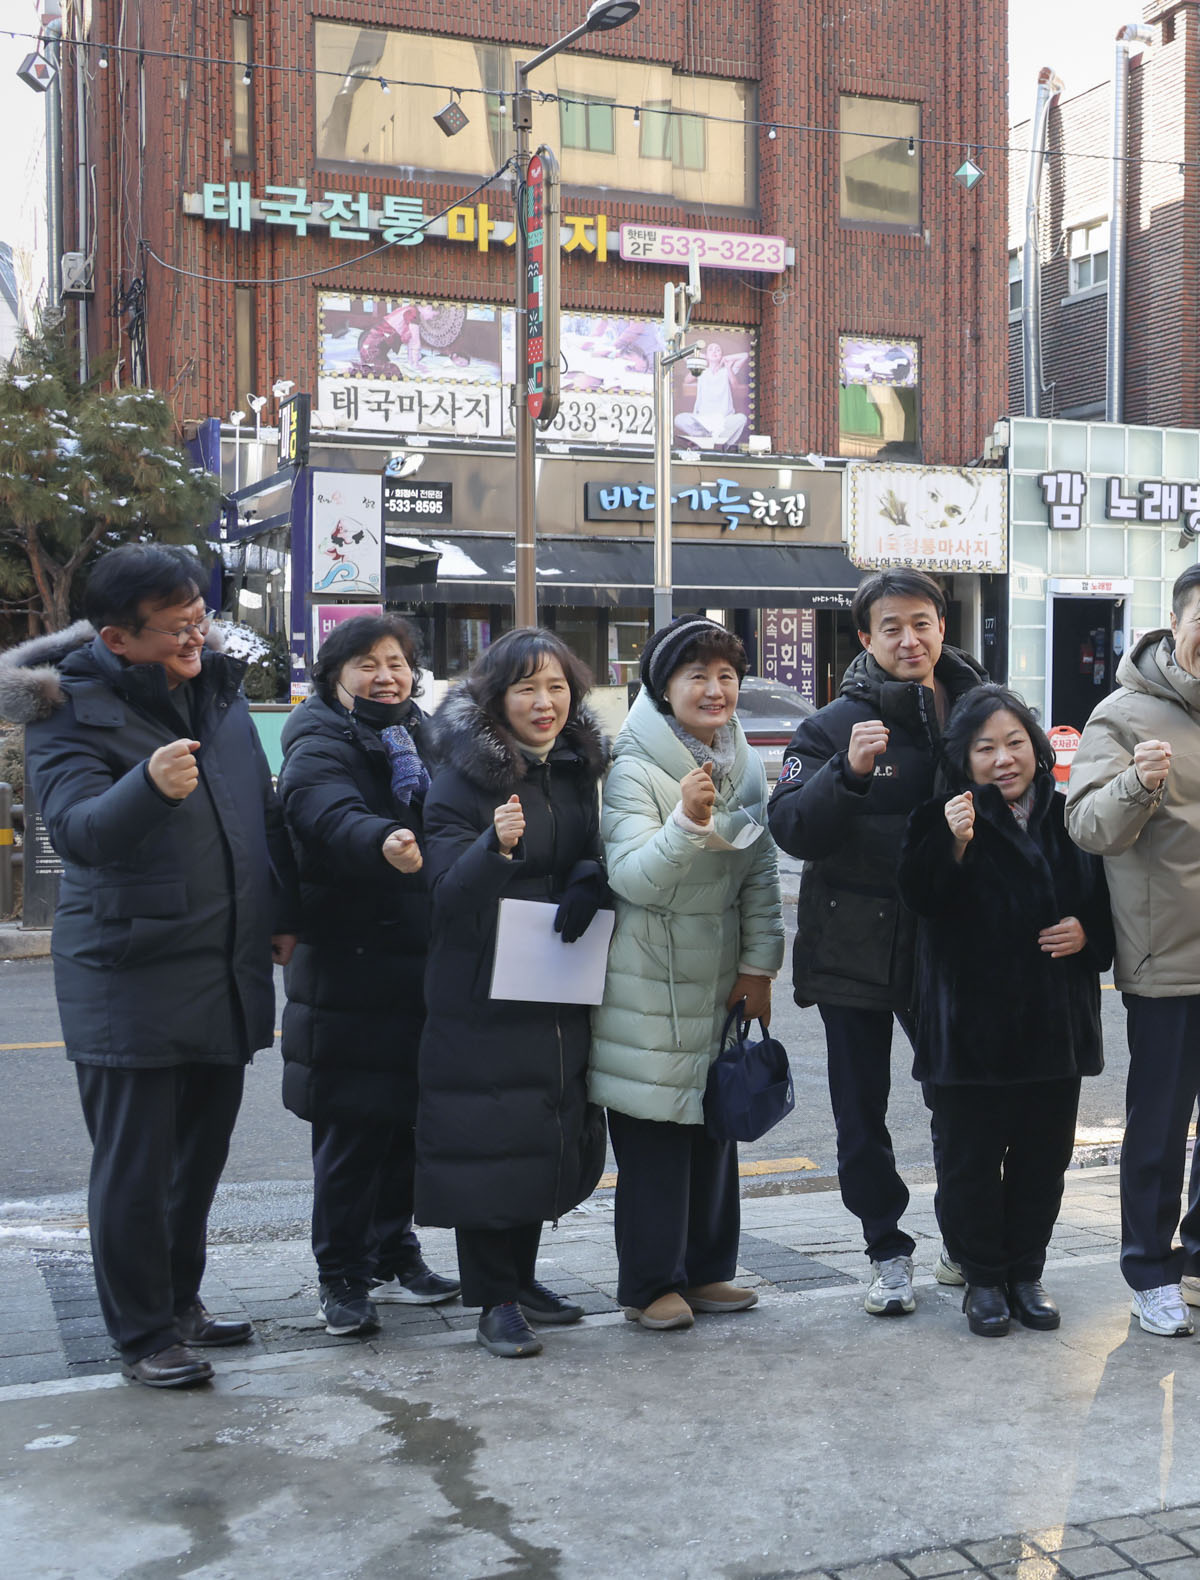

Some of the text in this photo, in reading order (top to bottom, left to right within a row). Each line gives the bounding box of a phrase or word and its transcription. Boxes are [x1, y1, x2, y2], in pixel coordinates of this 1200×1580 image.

[203, 181, 607, 263] 태국전통 마지
[630, 242, 654, 256] 2F
[660, 234, 781, 264] 533-3223
[330, 386, 491, 429] 태국마사지
[1039, 471, 1087, 531] 깜
[812, 593, 853, 608] 바다가득한
[801, 642, 813, 676] 메뉴
